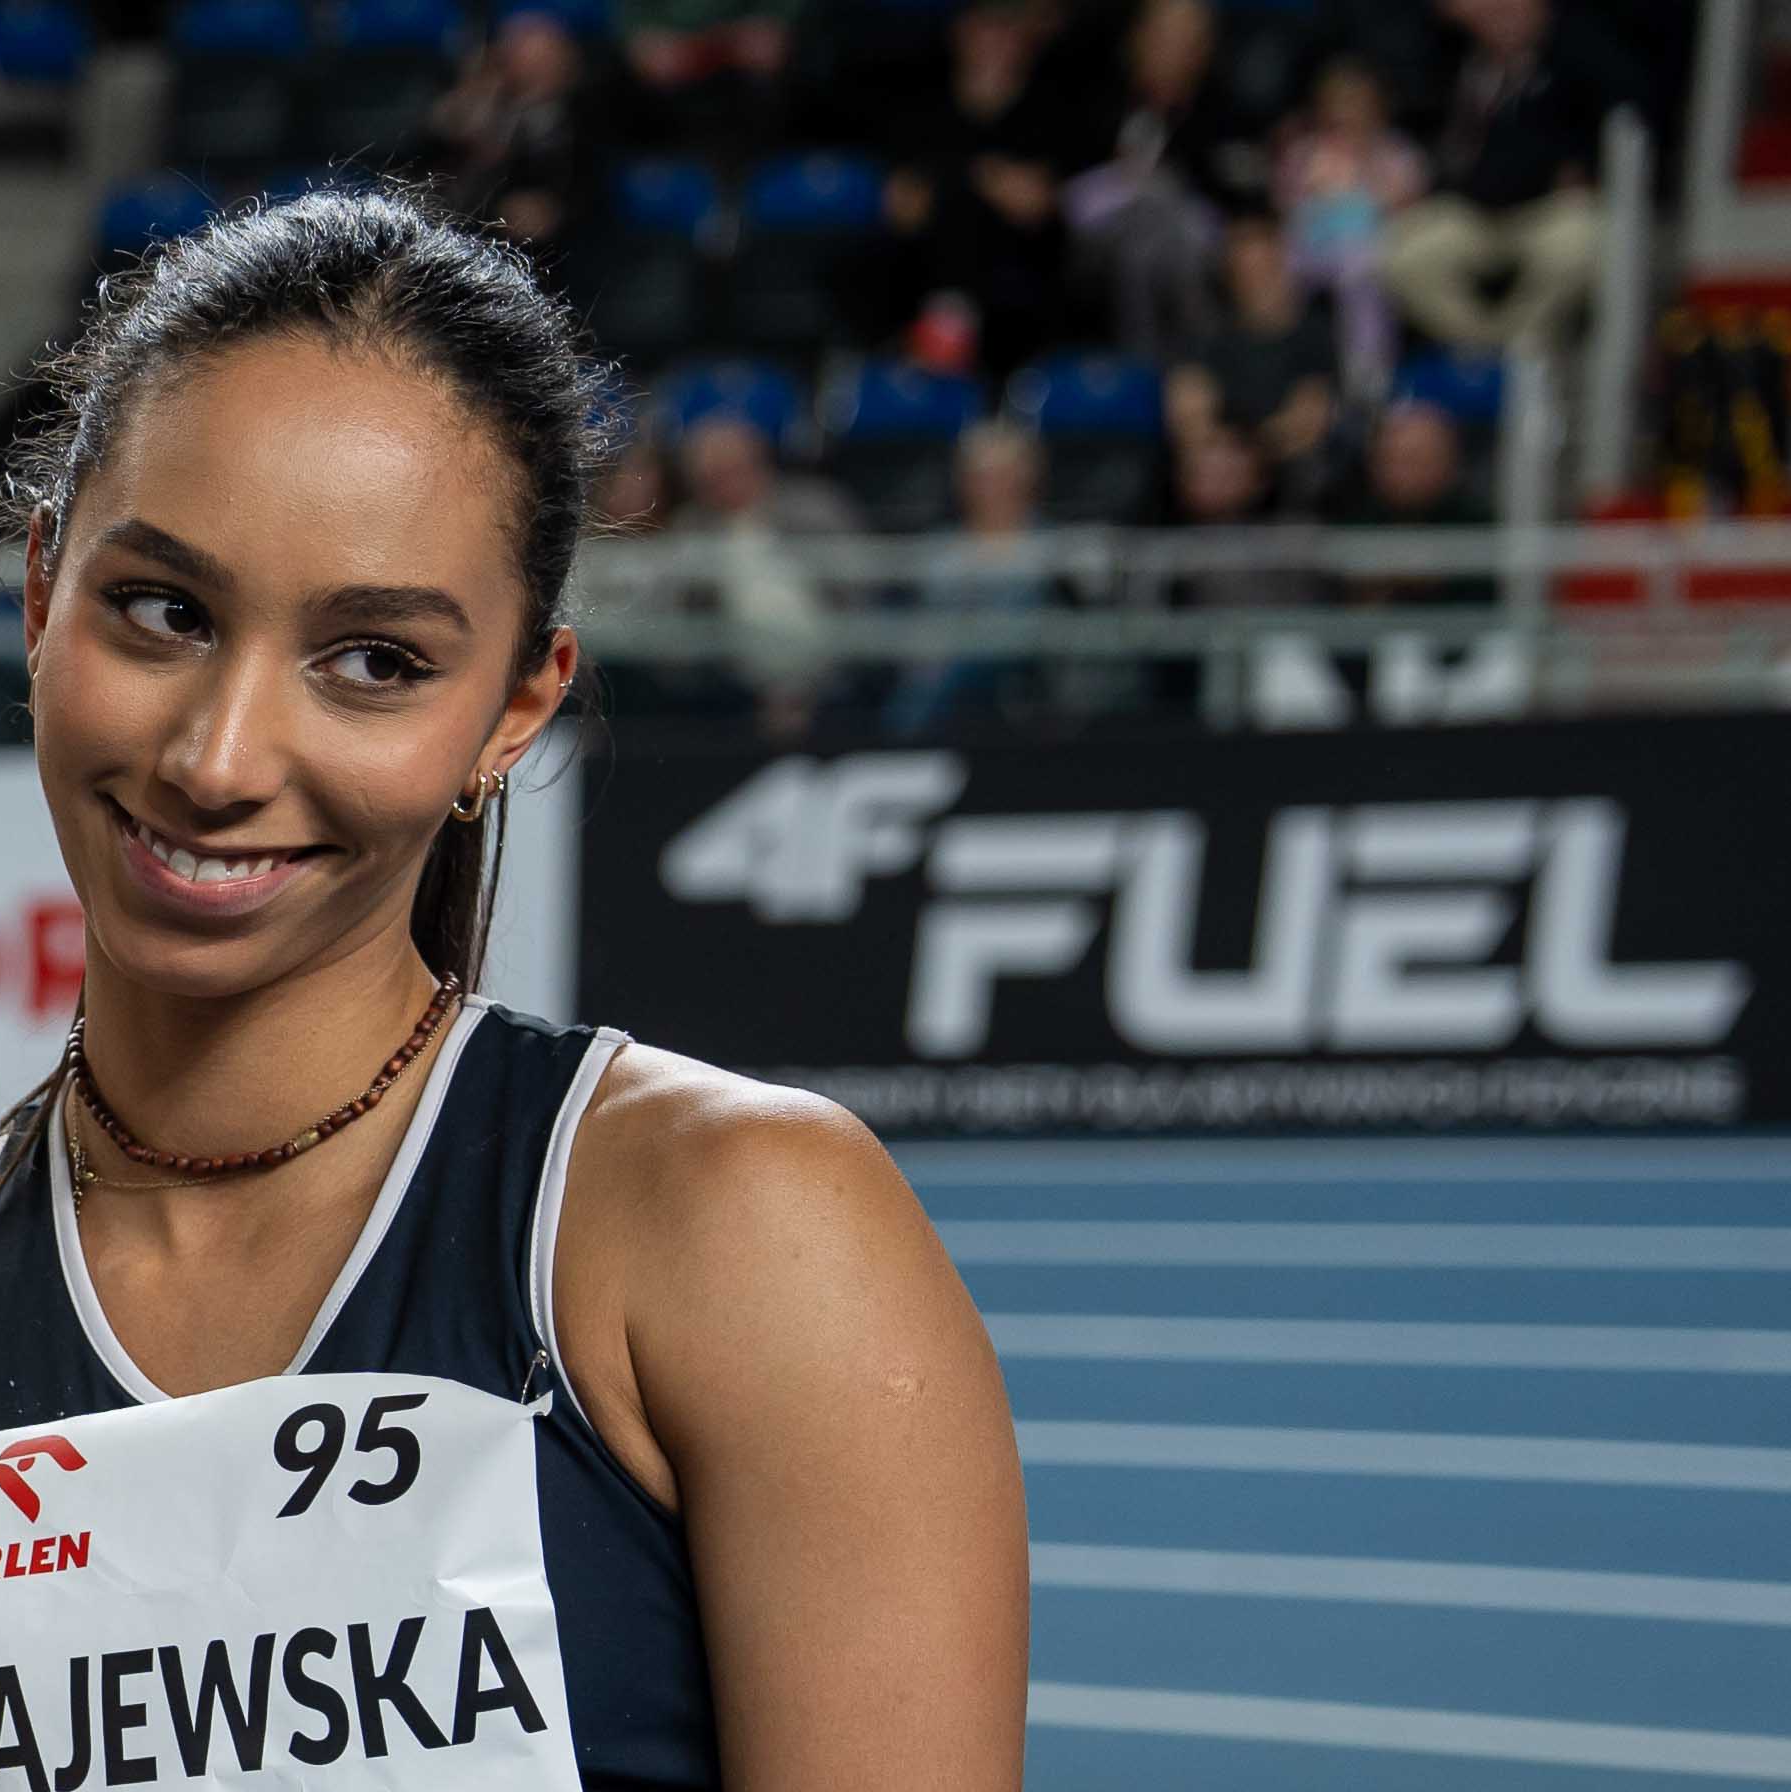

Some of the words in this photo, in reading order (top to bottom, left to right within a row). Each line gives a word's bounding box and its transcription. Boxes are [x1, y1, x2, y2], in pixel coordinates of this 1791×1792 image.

[662, 749, 972, 921] 4F
[905, 796, 1753, 1058] FUEL
[273, 1393, 430, 1518] 95
